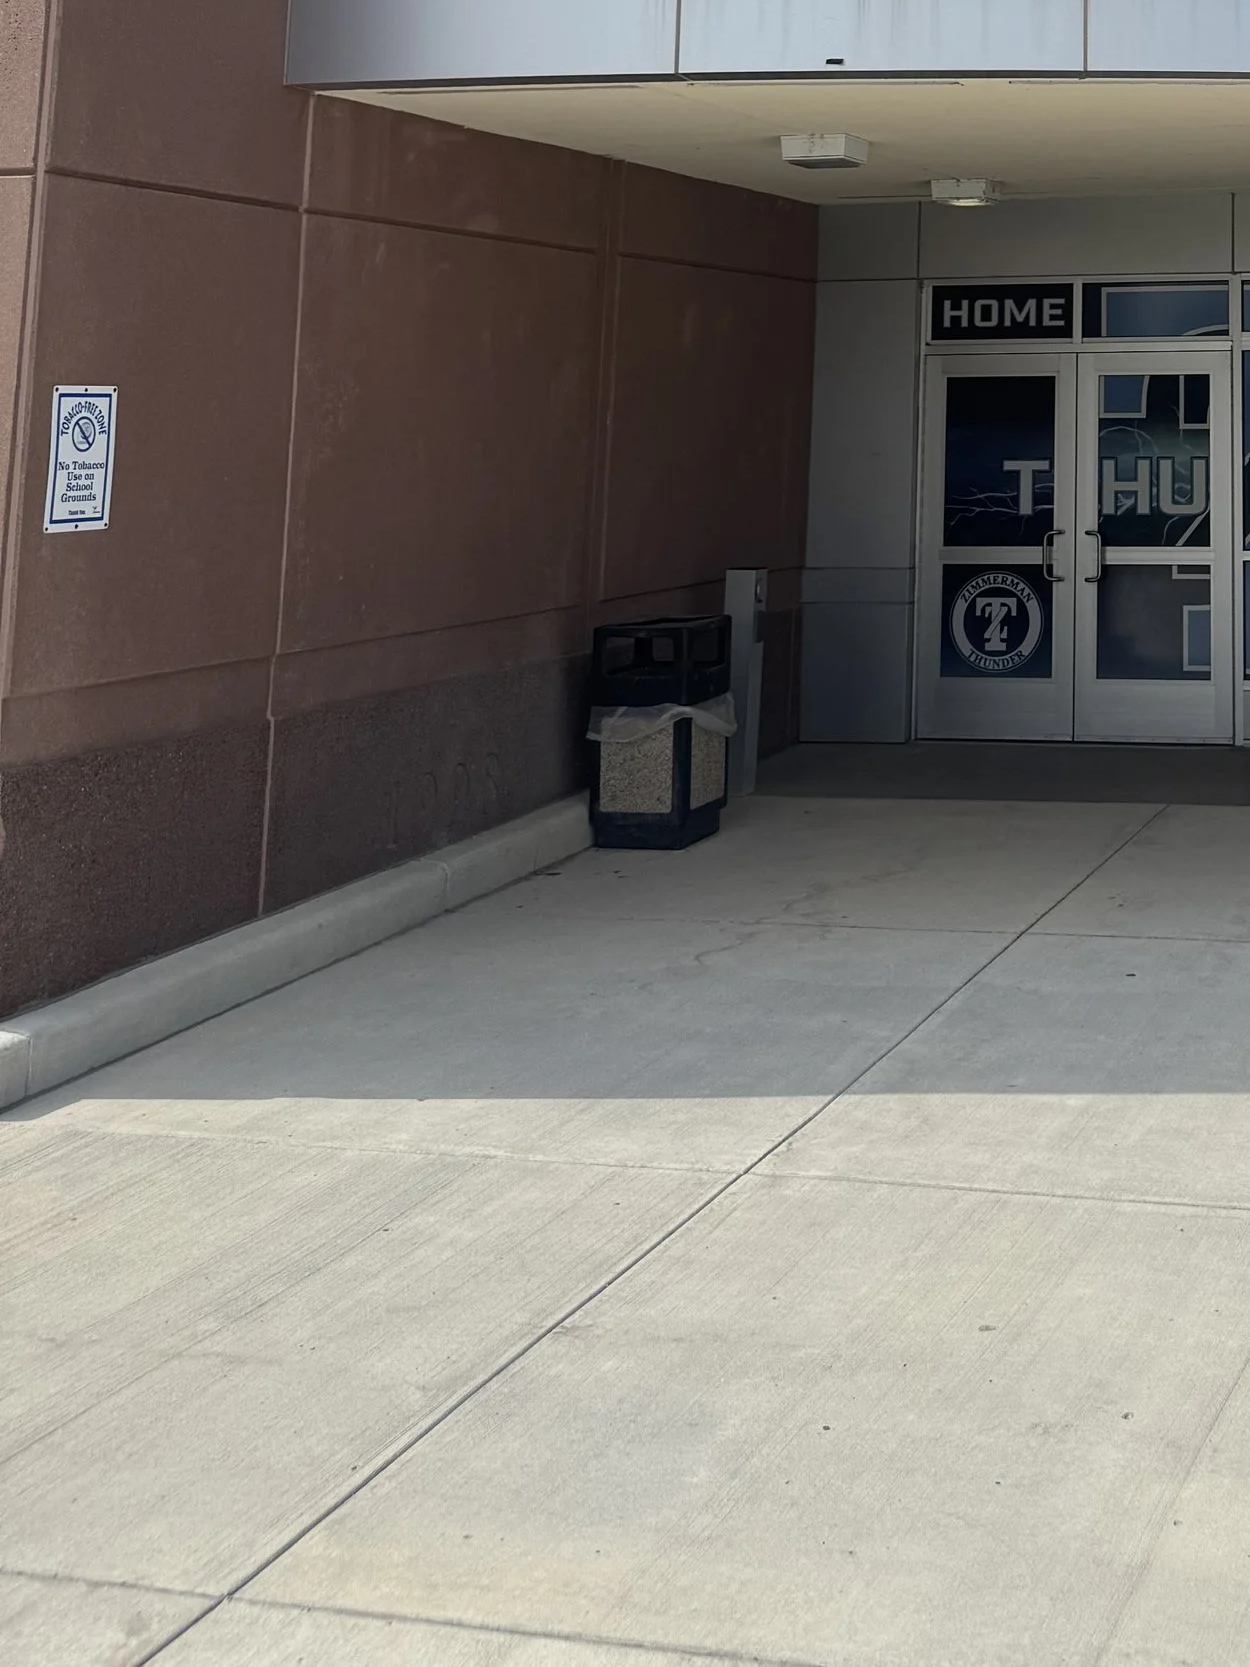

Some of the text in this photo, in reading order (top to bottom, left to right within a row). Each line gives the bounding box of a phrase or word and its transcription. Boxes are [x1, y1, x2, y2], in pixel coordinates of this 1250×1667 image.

[943, 298, 1065, 328] HOME
[61, 401, 106, 436] TOBACCO-FREE ZONE
[58, 460, 105, 471] No Tobacco
[67, 471, 95, 481] Use on
[65, 481, 94, 492] School
[60, 492, 97, 503] Grounds
[960, 575, 1034, 604] ZIMMERMAN
[966, 648, 1026, 670] THUNDER
